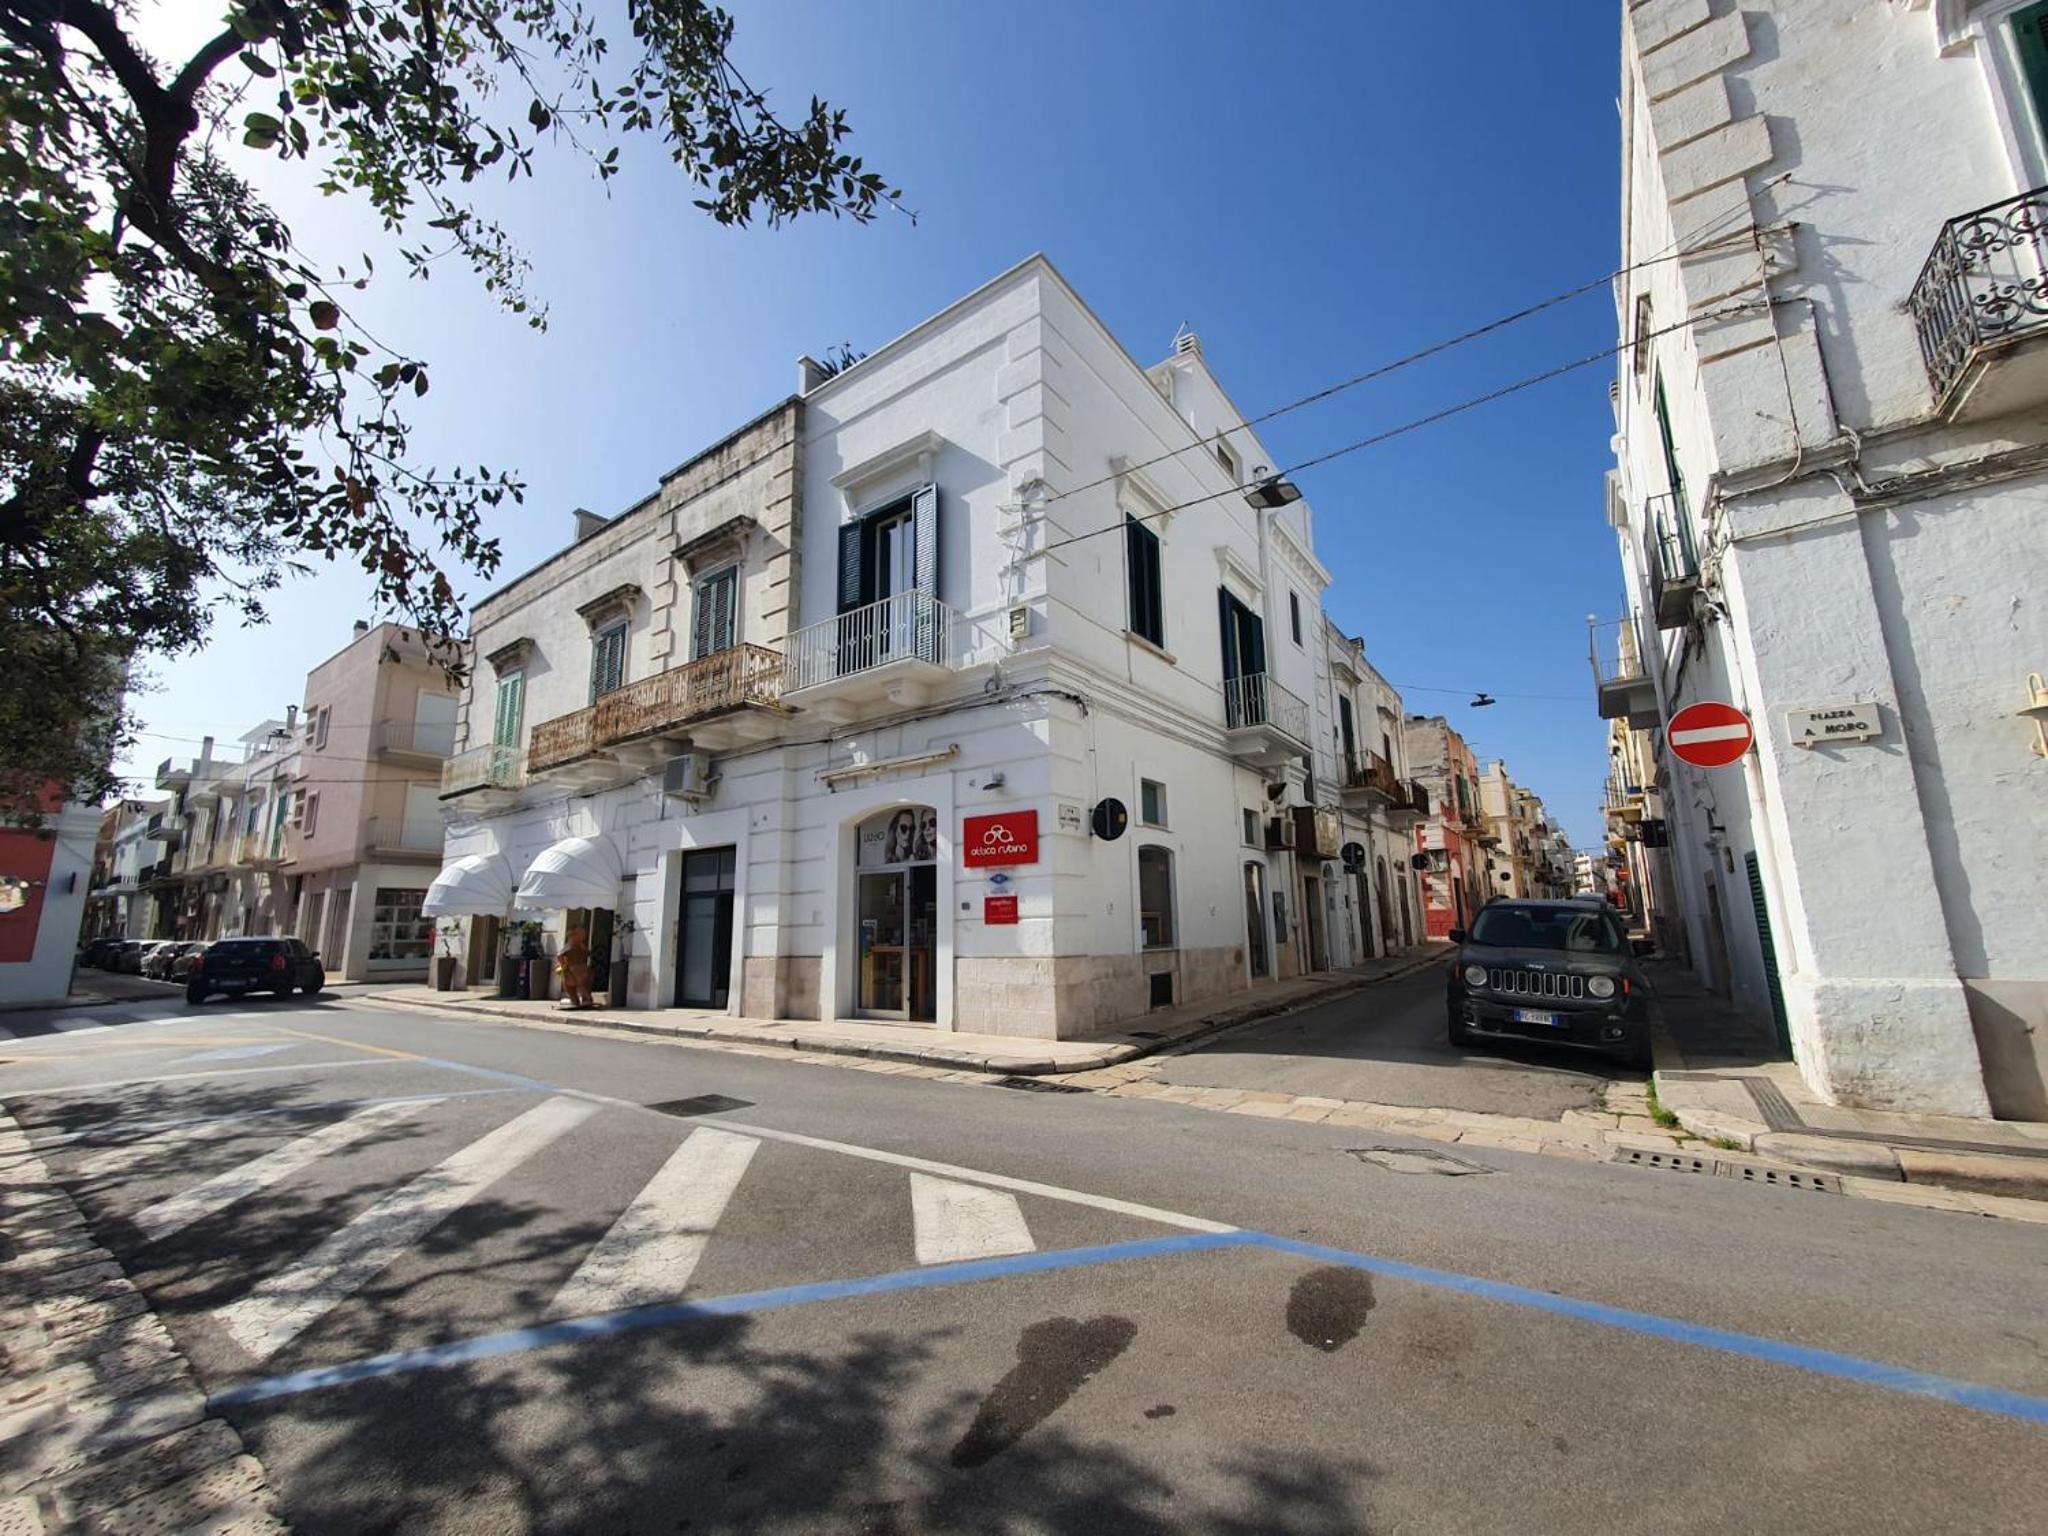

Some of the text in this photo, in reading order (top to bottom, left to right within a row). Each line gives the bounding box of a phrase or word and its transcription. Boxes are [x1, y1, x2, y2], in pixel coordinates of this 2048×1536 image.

[1810, 710, 1855, 722] PIAZZA
[1825, 721, 1869, 734] MORO
[997, 844, 1028, 855] rubino
